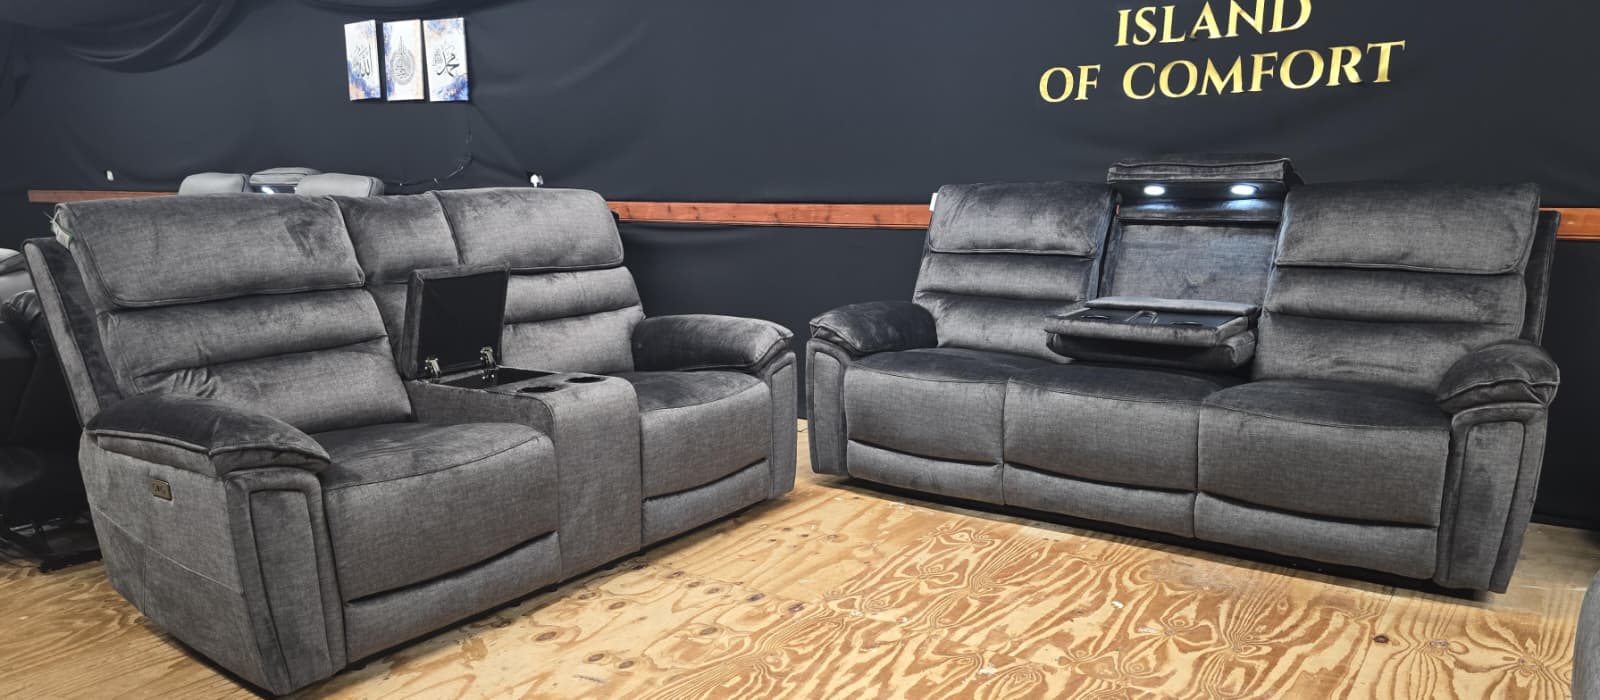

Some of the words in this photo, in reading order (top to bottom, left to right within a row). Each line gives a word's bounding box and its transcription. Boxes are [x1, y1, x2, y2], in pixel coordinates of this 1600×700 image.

[1114, 0, 1312, 47] ISLAND
[1039, 64, 1100, 103] OF
[1122, 40, 1406, 100] COMFORT
